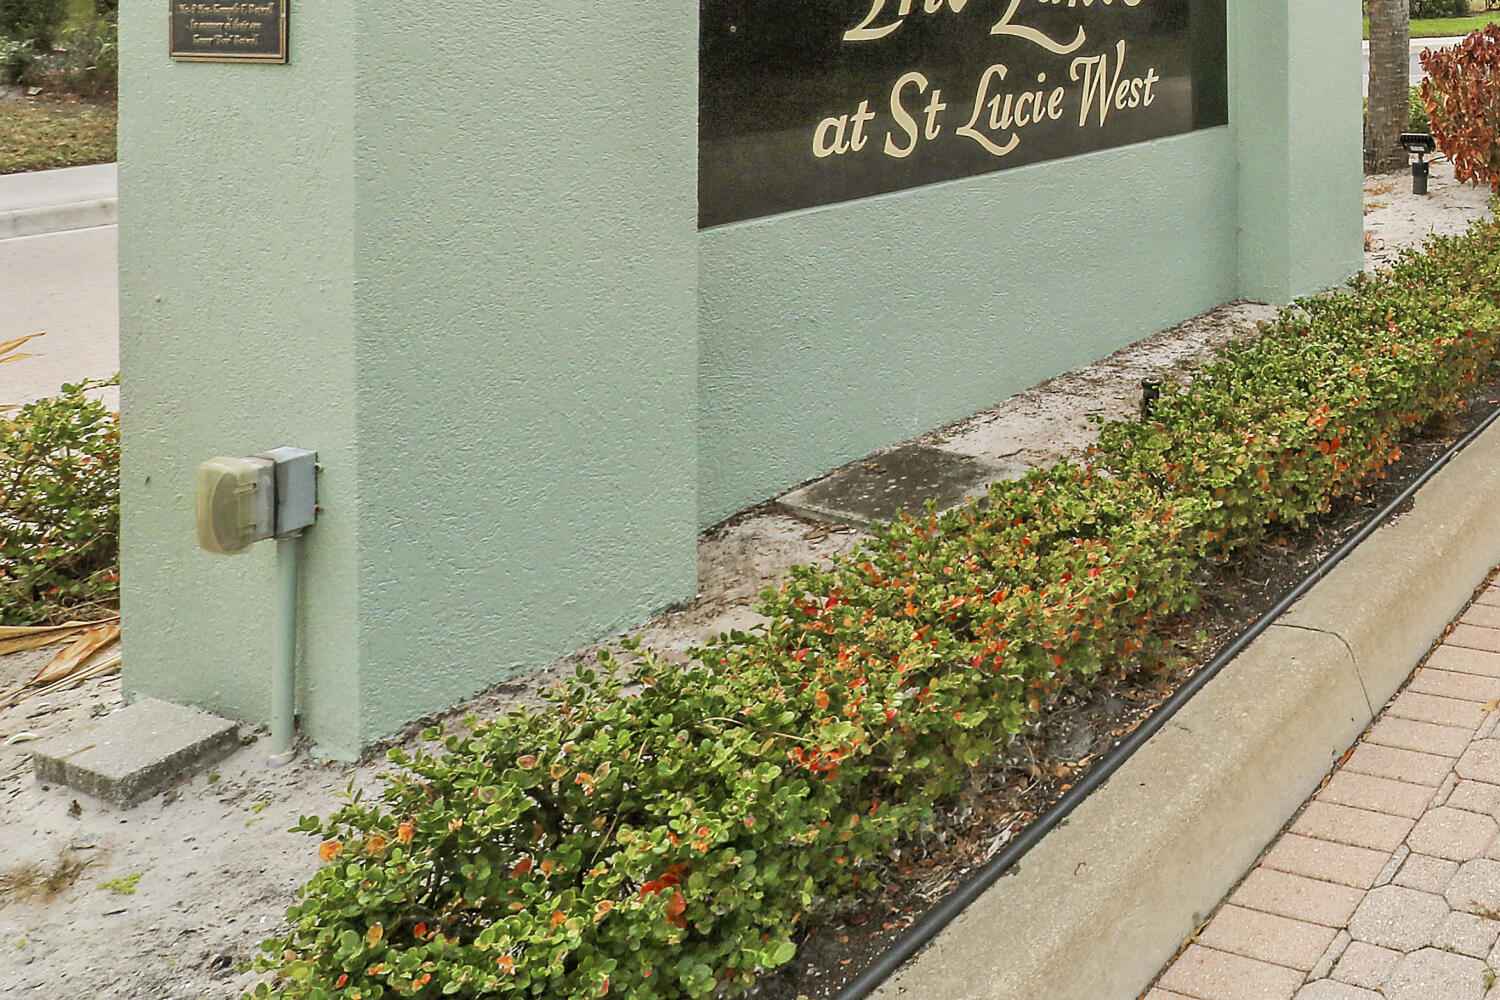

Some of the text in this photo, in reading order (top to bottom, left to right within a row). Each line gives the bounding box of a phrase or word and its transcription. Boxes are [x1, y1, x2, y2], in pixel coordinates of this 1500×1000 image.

[812, 39, 1161, 159] at St Lucie West
